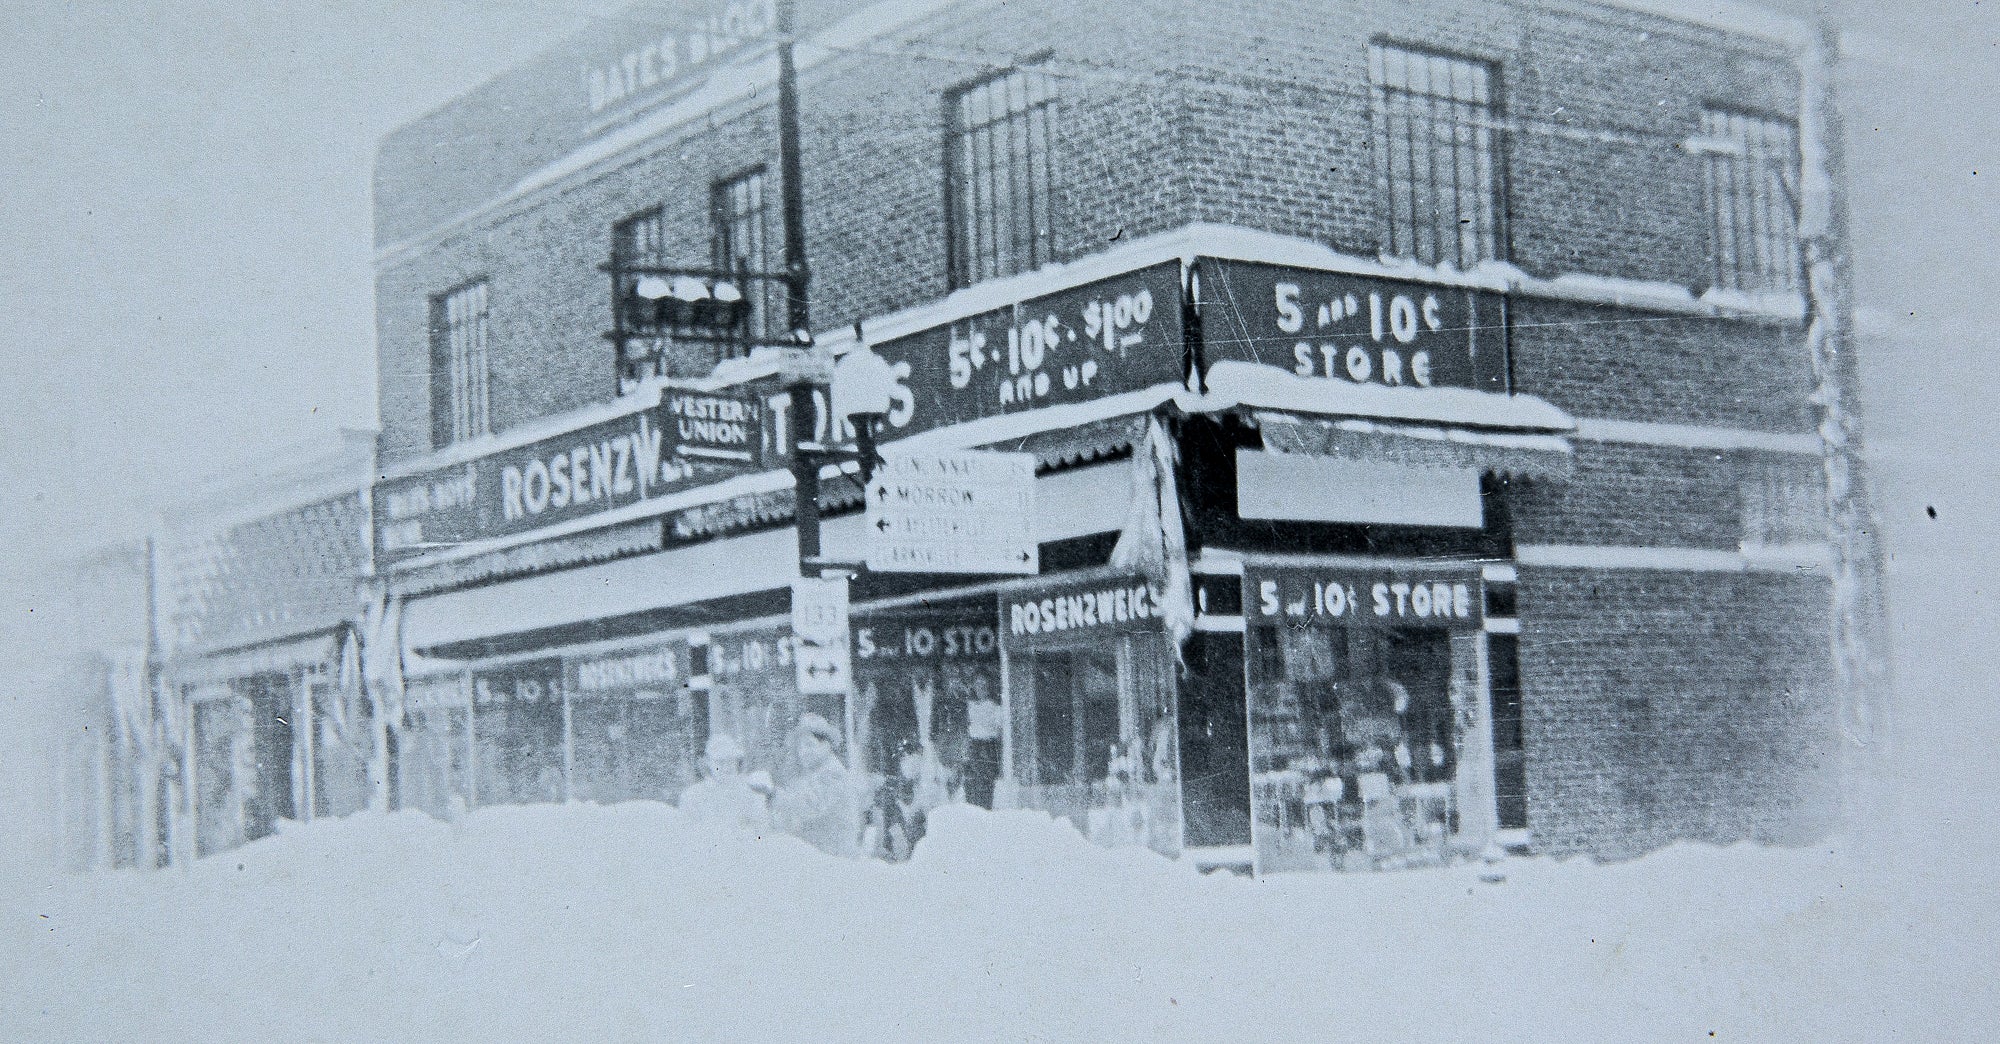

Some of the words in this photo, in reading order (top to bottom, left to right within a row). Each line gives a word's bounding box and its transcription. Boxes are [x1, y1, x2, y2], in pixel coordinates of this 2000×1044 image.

[1275, 282, 1302, 333] 5
[1062, 360, 1098, 390] UP
[1294, 341, 1431, 388] STORE
[677, 418, 747, 445] UNION
[896, 484, 974, 507] MORROW
[1260, 580, 1279, 616] 5
[1371, 582, 1470, 618] STORE
[857, 628, 876, 658] 5
[944, 625, 996, 657] STO
